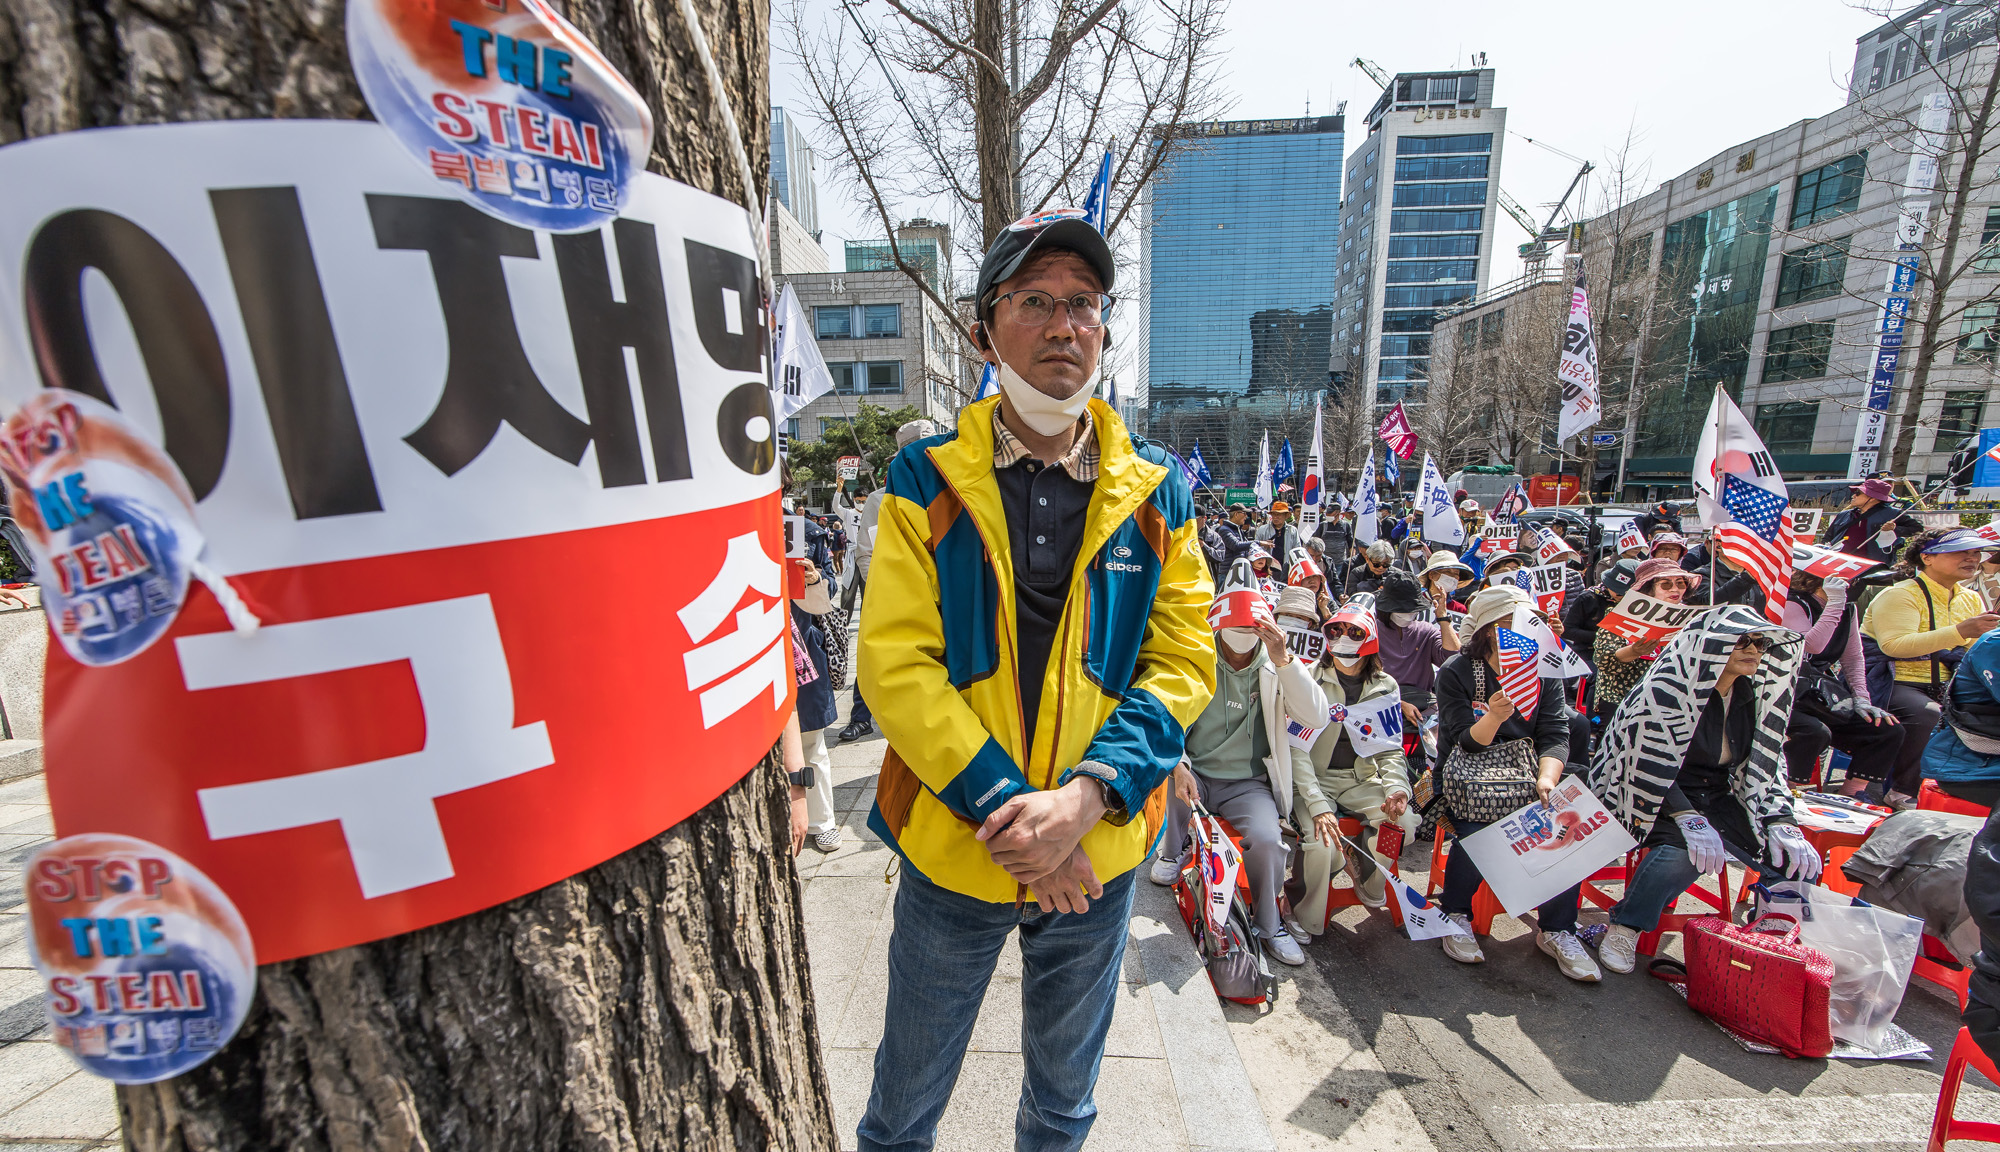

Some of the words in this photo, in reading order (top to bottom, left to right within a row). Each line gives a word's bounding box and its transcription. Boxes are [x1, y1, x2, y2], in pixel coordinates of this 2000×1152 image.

[450, 19, 572, 97] THE
[1707, 279, 1732, 295] 세광
[23, 186, 776, 519] 이재명
[1865, 427, 1878, 445] 세광
[174, 530, 789, 898] 구속
[1227, 700, 1243, 710] FIFA
[1555, 825, 1570, 842] THE
[1573, 810, 1610, 842] STOP
[36, 859, 173, 902] STOP
[61, 916, 167, 958] THE
